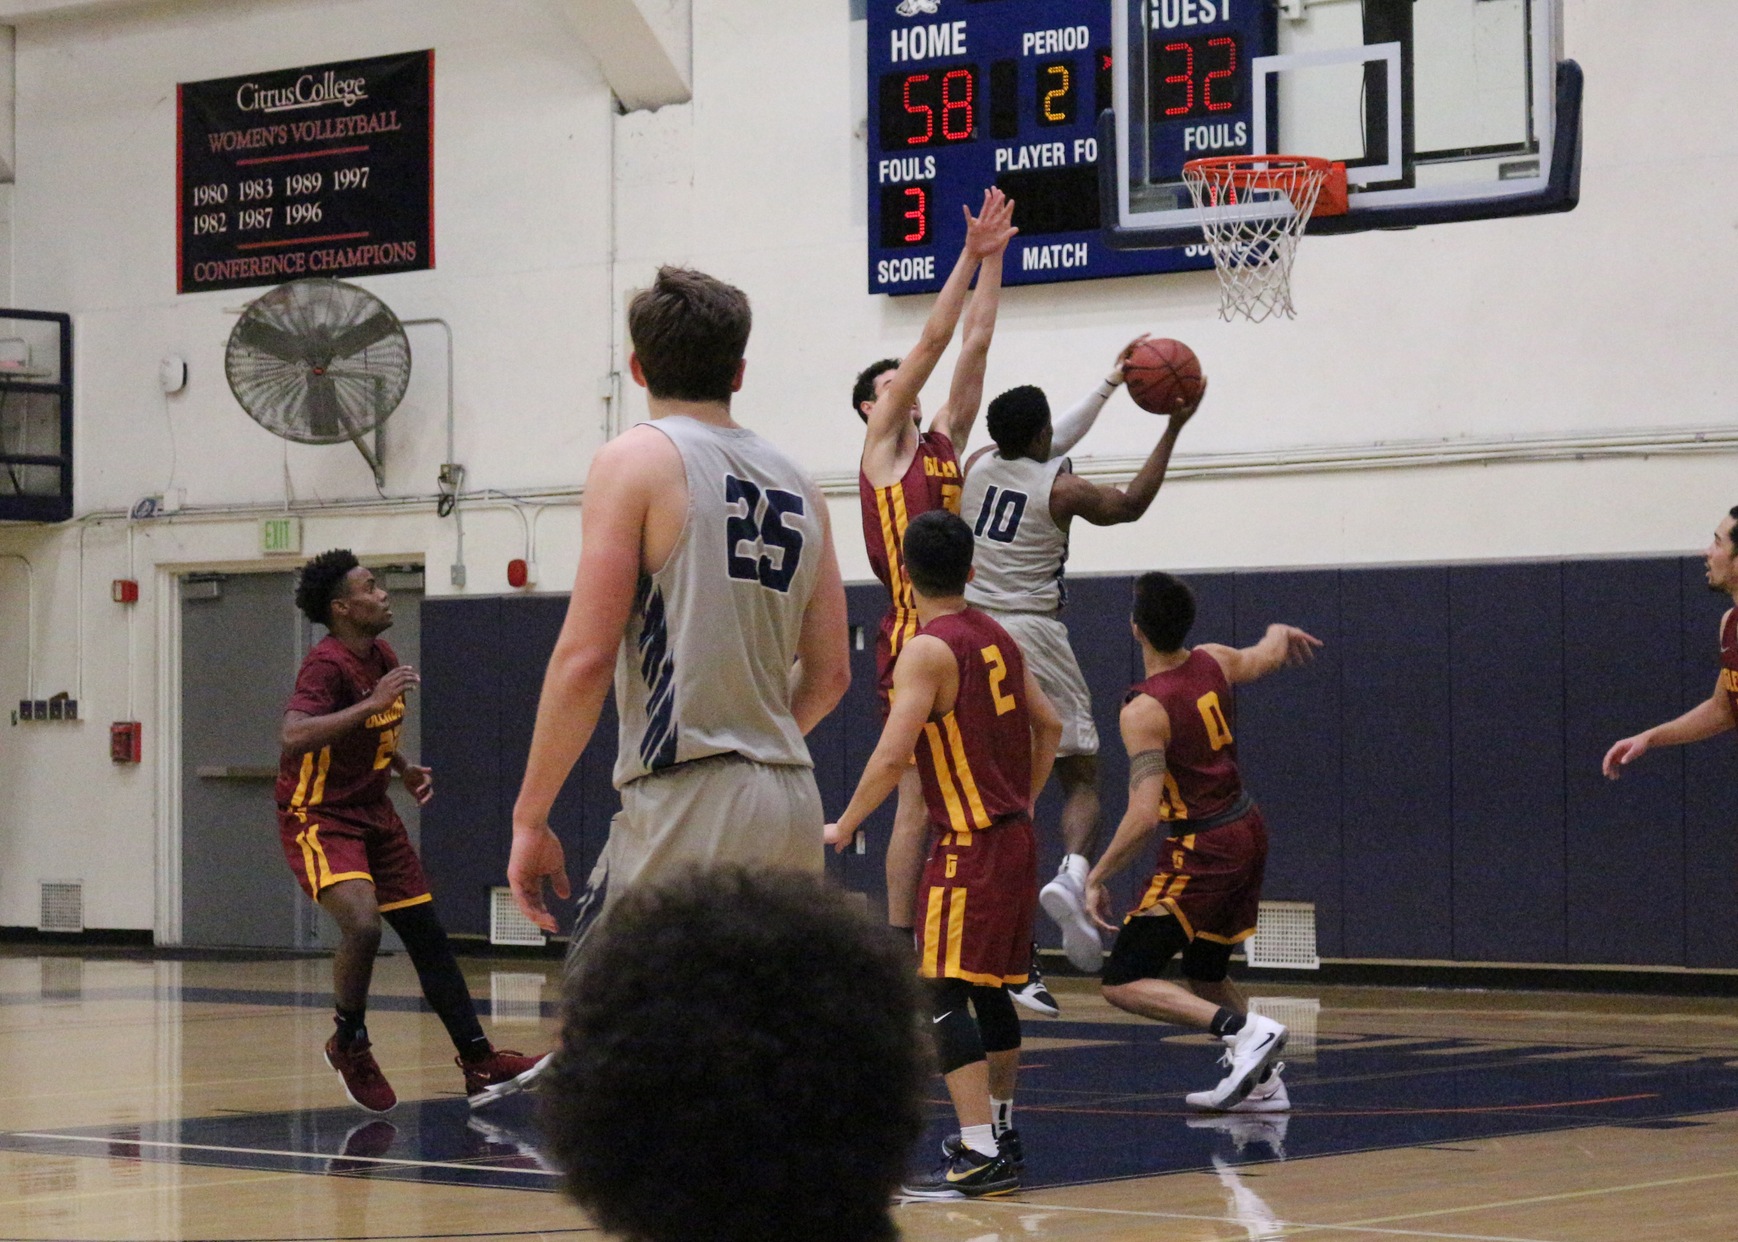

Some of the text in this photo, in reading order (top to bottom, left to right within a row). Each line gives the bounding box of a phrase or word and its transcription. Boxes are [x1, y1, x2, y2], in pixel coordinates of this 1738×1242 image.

[891, 21, 967, 62] HOME
[1023, 25, 1089, 56] PERIOD
[1044, 65, 1069, 121] 2
[1165, 37, 1236, 116] 32
[903, 69, 973, 144] 58
[208, 110, 401, 153] WOMEN'S VOLLEYBALL
[1184, 121, 1247, 151] FOULS
[879, 155, 936, 183] FOULS
[995, 142, 1066, 172] PLAYER
[193, 166, 370, 207] 1980 1983 1989 1997
[193, 202, 322, 236] 1982 1987 1996
[904, 187, 925, 242] 3
[194, 241, 417, 283] CONFERENCE CHAMPIONS
[878, 256, 935, 283] SCORE
[1022, 242, 1088, 271] MATCH
[264, 520, 290, 550] EXIT
[725, 473, 805, 594] 25
[974, 484, 1028, 545] 10
[980, 644, 1016, 717] 2
[1197, 691, 1233, 751] 0
